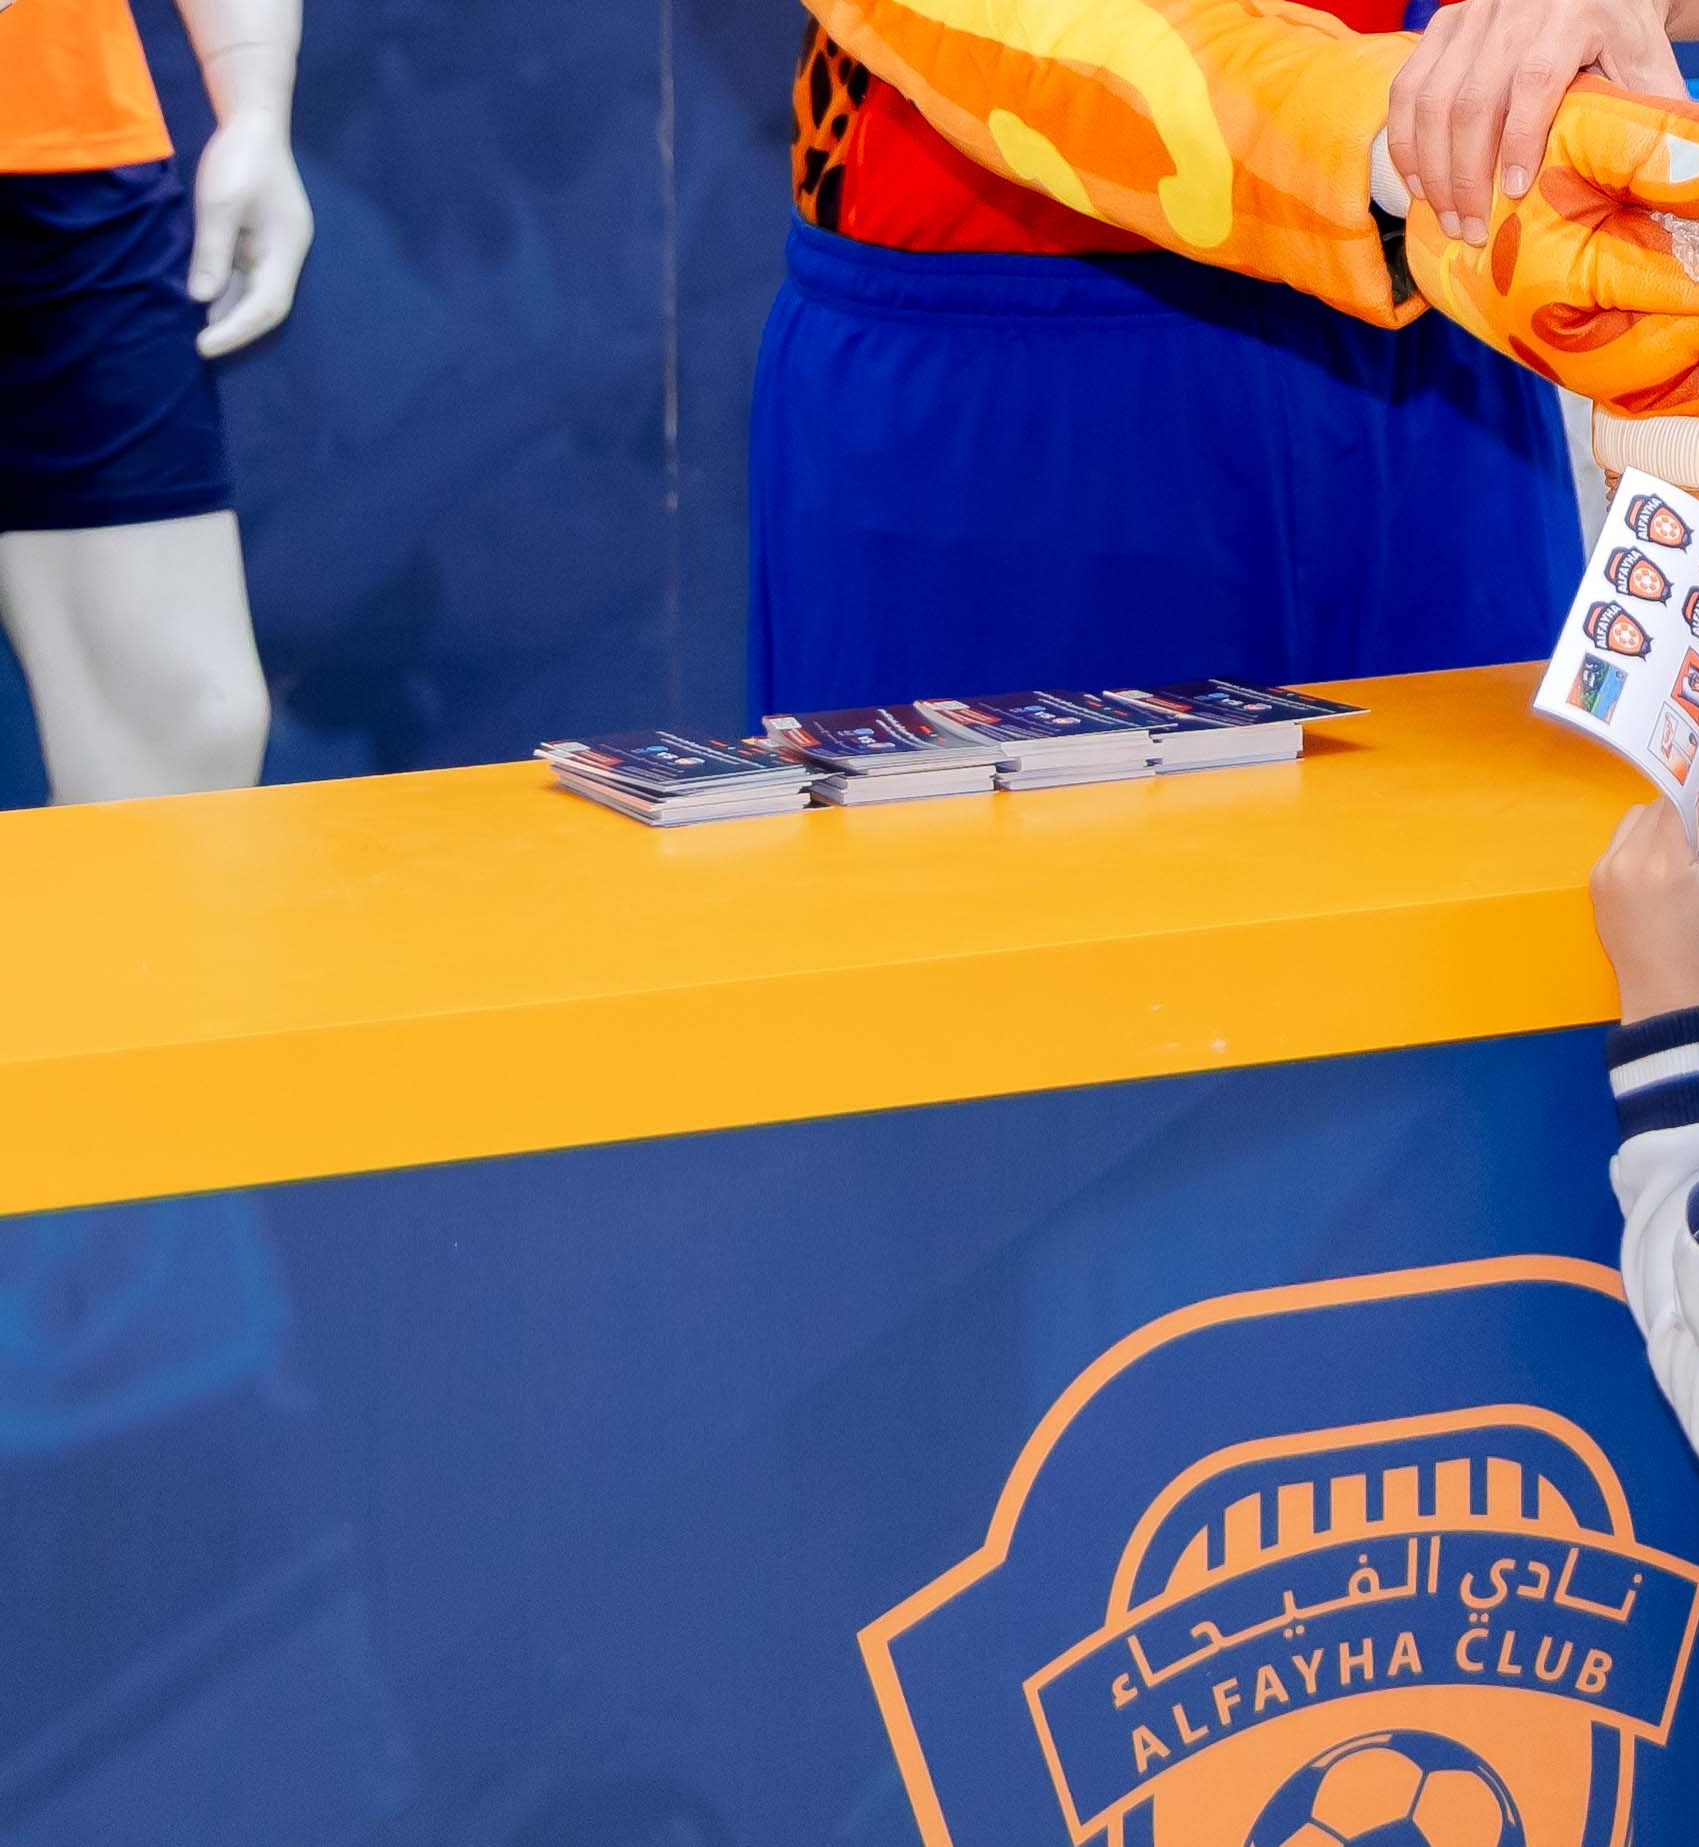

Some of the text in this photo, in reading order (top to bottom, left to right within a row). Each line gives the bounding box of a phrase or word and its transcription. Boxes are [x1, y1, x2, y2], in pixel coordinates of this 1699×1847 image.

[1637, 496, 1663, 540] ALFAYHA
[1617, 549, 1643, 594] ALFAYHA
[1596, 604, 1623, 649] ALFAYHA
[1111, 1535, 1644, 1709] نادي الفيحاء
[1131, 1626, 1614, 1774] ALFAYHA CLUB
